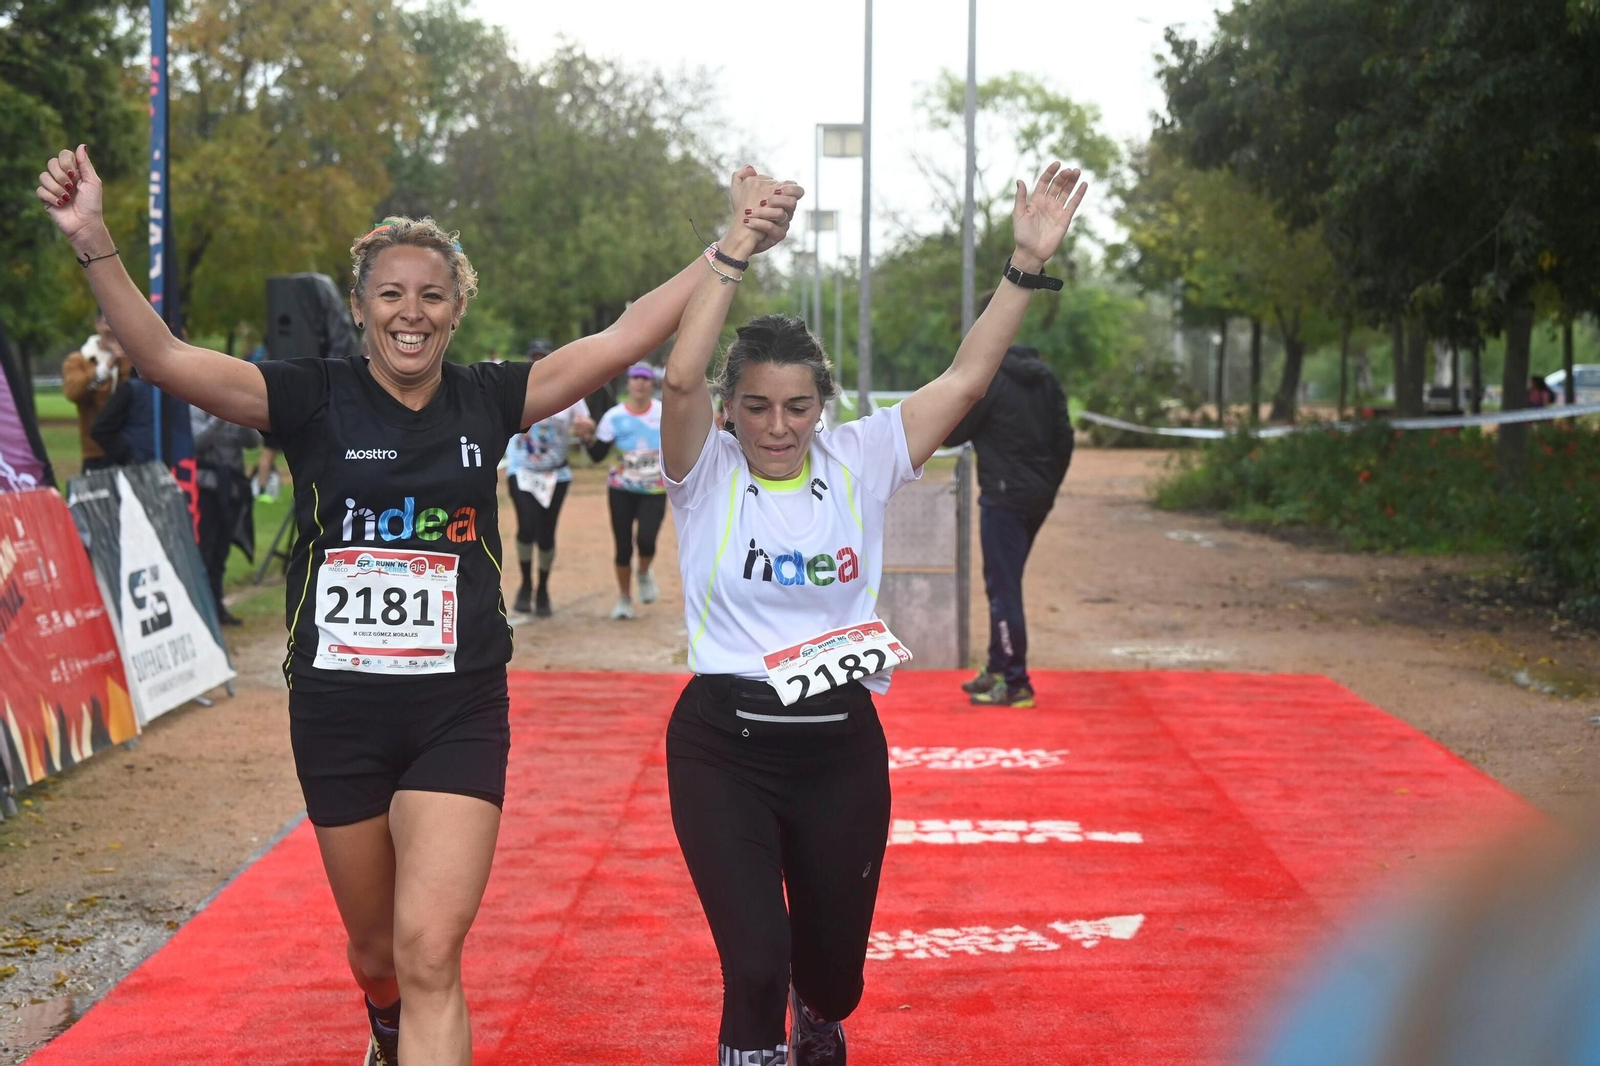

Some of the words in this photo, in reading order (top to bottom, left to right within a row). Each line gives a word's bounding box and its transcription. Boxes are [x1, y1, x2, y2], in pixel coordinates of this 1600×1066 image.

[460, 436, 482, 467] in
[342, 496, 477, 543] indea
[410, 562, 426, 573] aje
[743, 538, 859, 586] indea
[324, 585, 435, 626] 2181
[443, 600, 454, 633] PAREJAS
[786, 648, 887, 704] 2182
